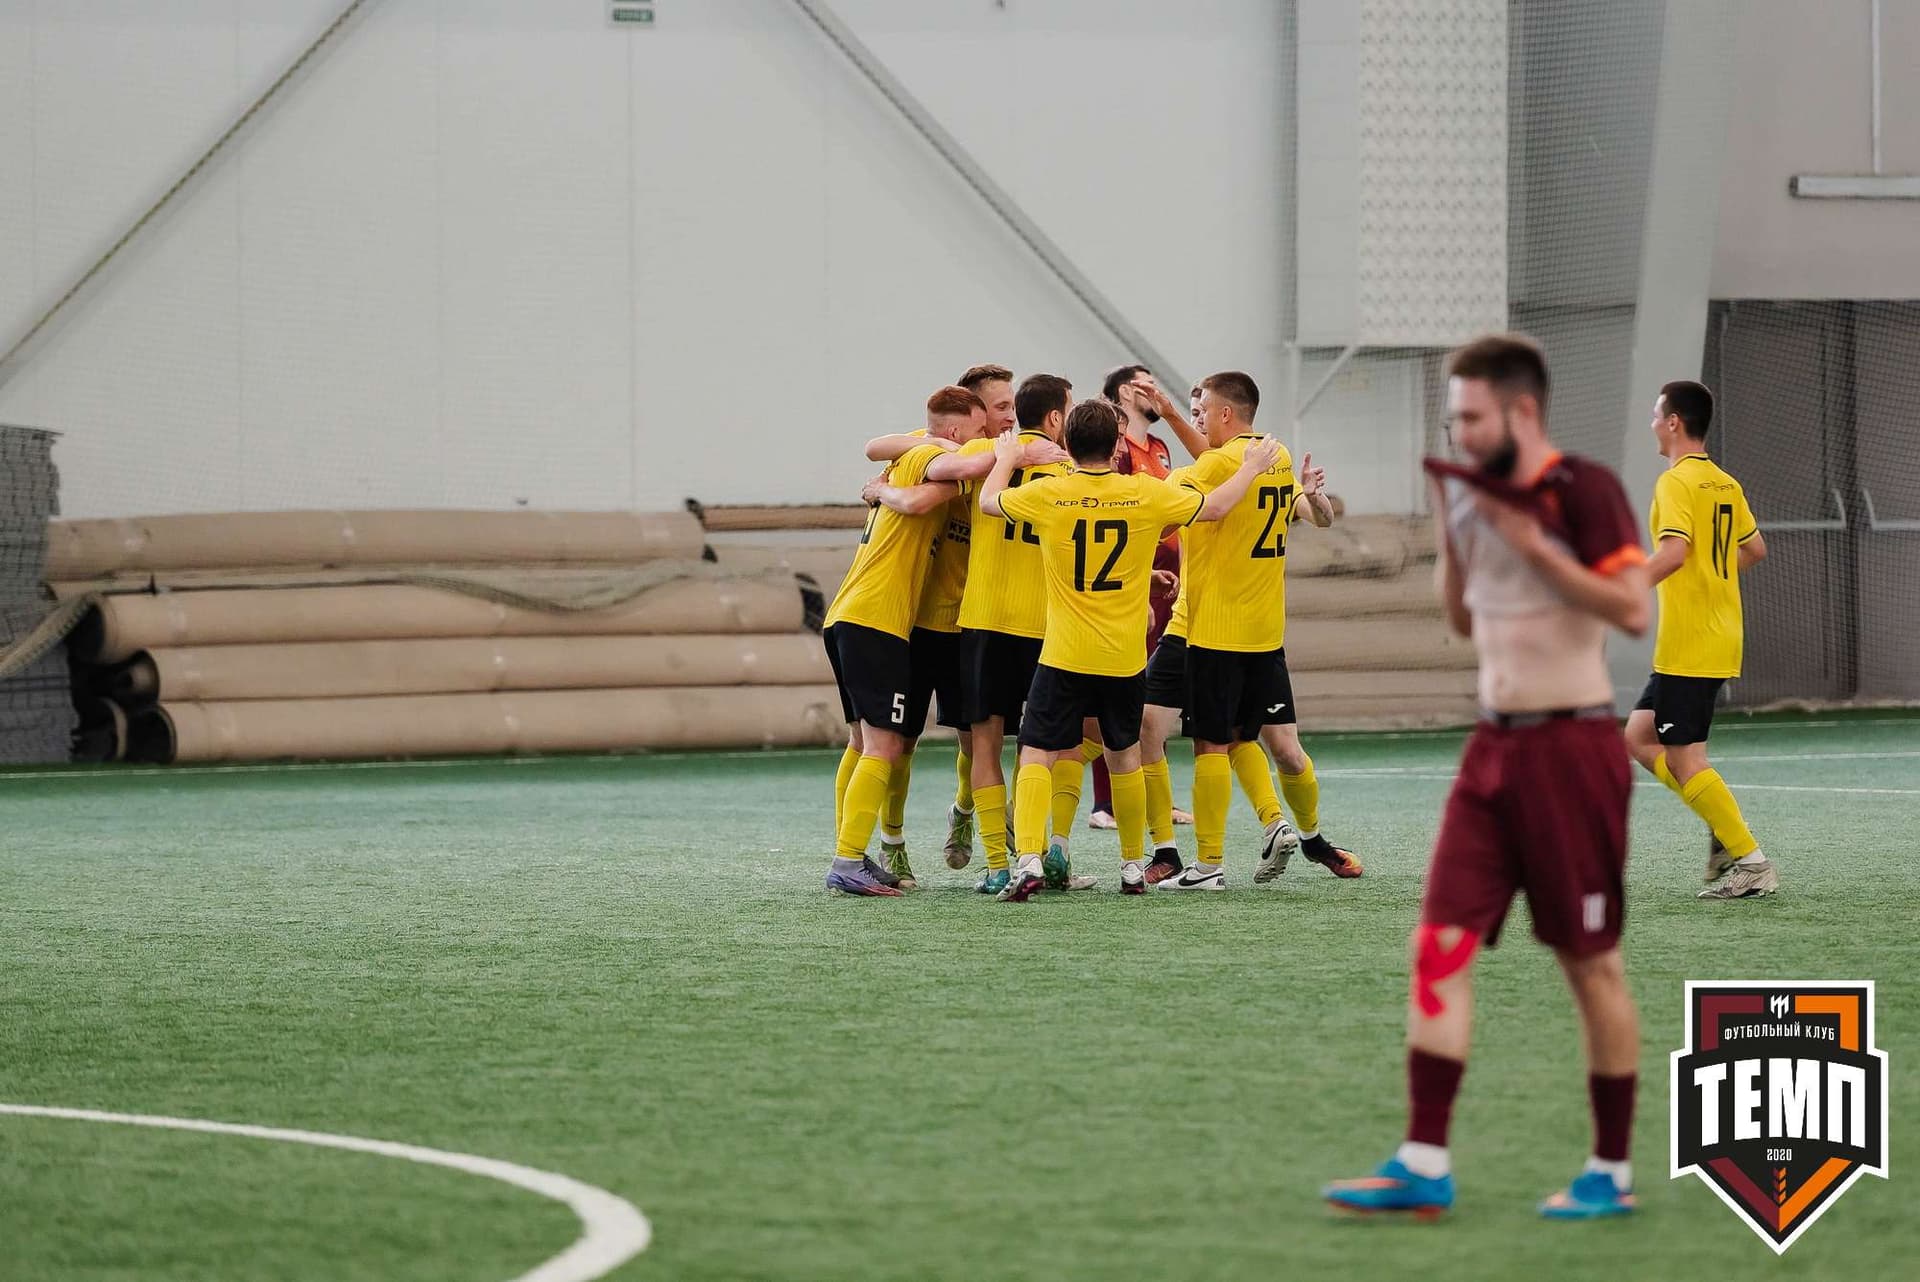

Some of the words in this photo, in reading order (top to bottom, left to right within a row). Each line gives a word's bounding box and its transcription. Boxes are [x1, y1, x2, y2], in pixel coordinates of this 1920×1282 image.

[1071, 518, 1128, 592] 12
[1251, 485, 1294, 558] 23
[891, 692, 905, 724] 5
